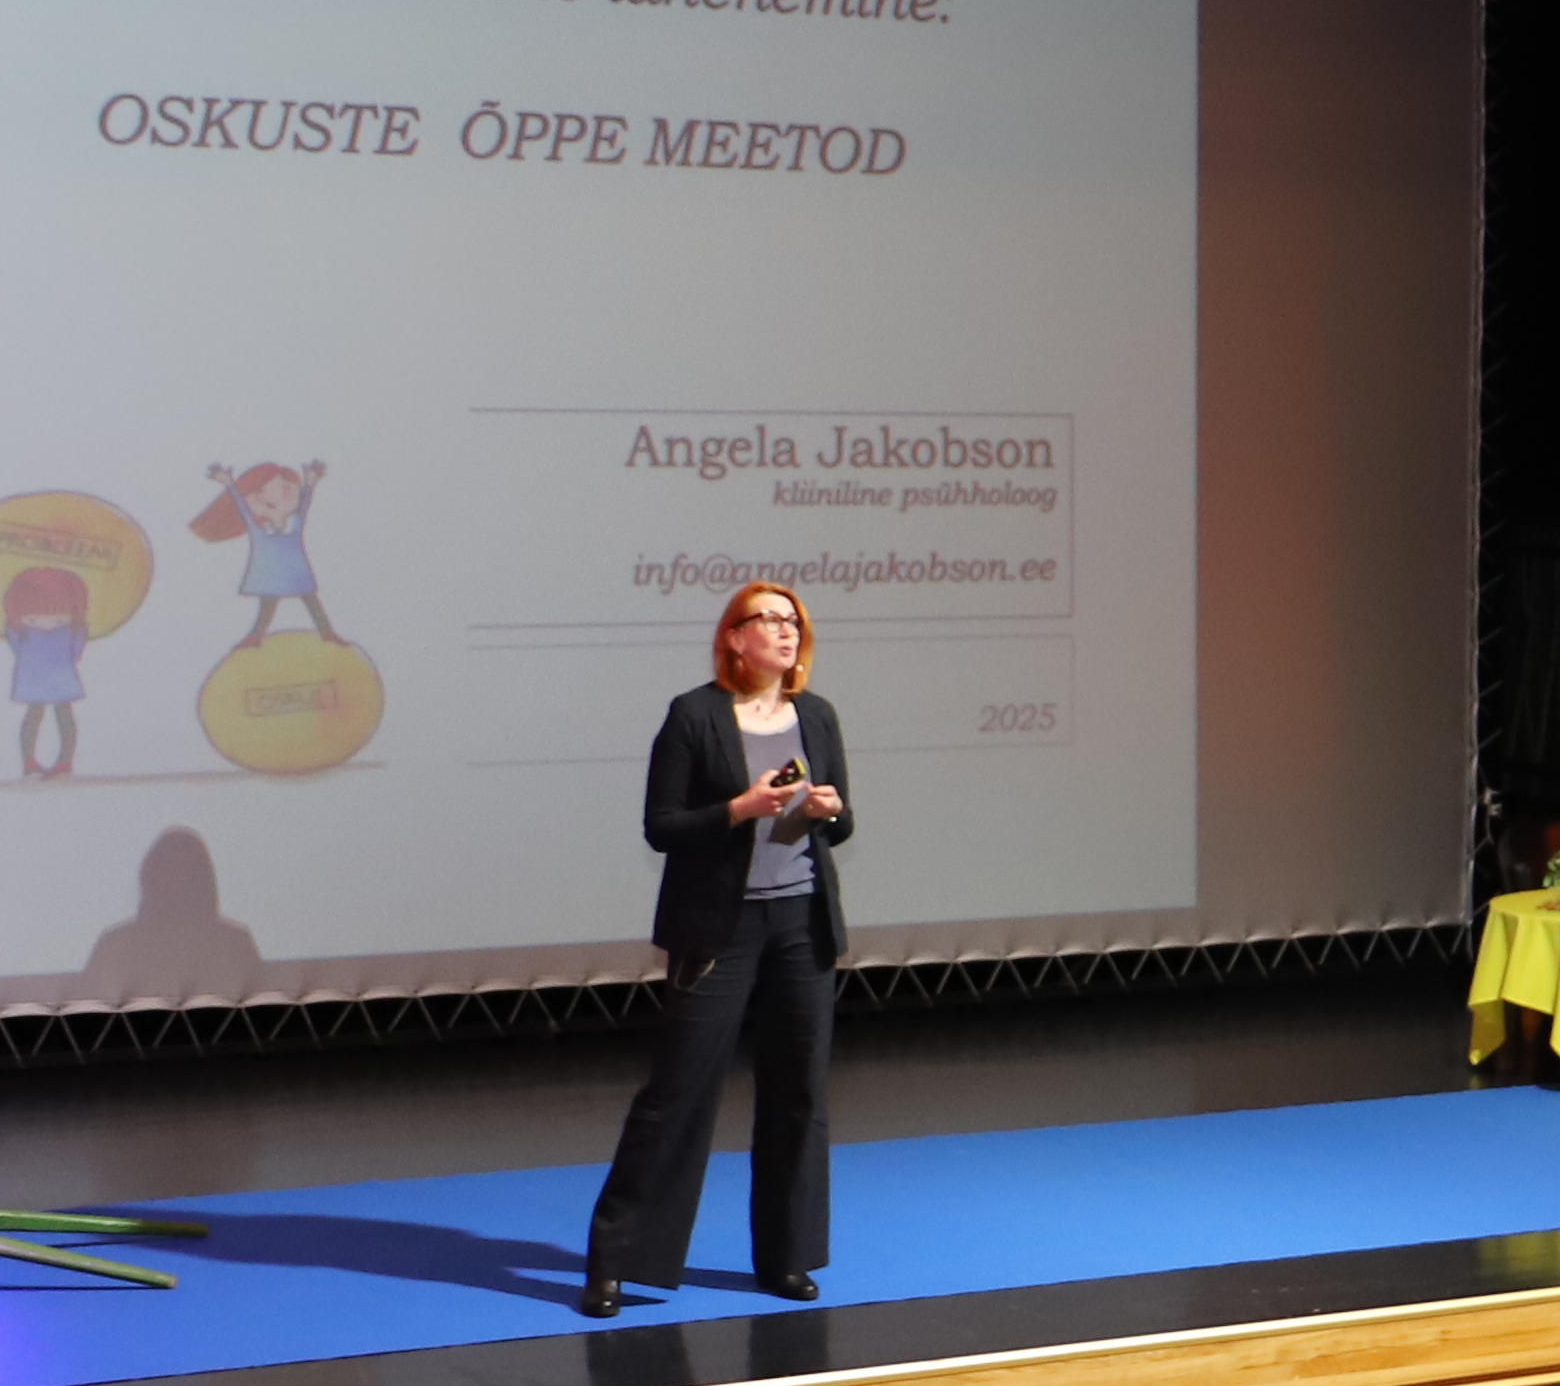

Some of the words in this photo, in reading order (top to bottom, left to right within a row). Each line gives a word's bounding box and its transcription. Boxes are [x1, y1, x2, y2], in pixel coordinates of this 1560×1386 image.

[97, 93, 421, 158] OSKUSTE
[460, 100, 629, 165] ÕPPE
[645, 118, 907, 176] MEETOD
[625, 424, 801, 481] Angela
[816, 424, 1056, 471] Jakobson
[900, 480, 1058, 513] psühholoog
[633, 551, 1057, 595] info@angelajakobson.ee
[978, 703, 1057, 734] 2025
